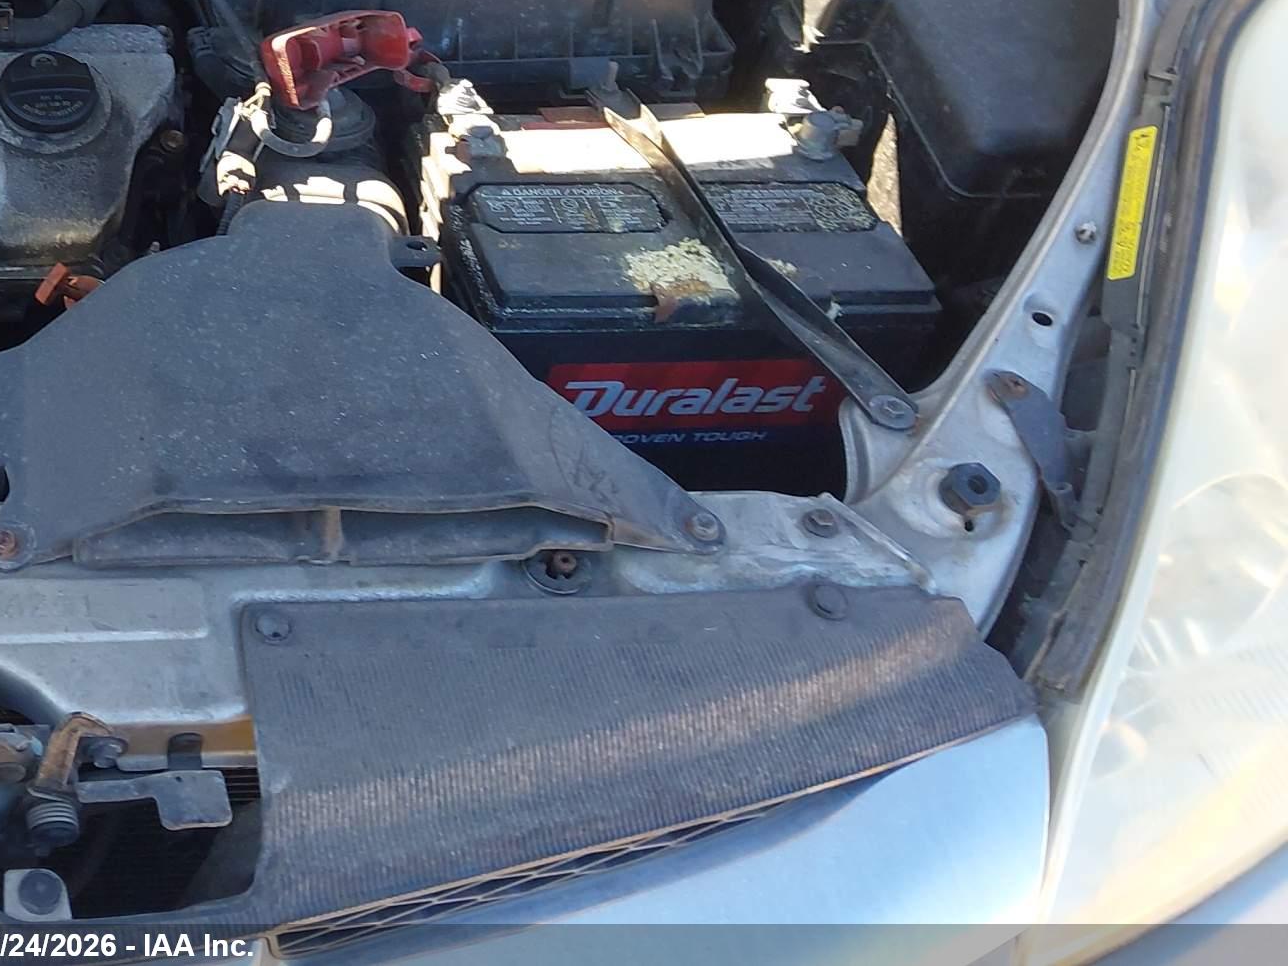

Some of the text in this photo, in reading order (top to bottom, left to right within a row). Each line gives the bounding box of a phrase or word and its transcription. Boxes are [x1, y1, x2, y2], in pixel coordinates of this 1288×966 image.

[513, 187, 562, 196] DANGER
[565, 376, 825, 416] Duralast
[693, 431, 767, 441] TOUGH
